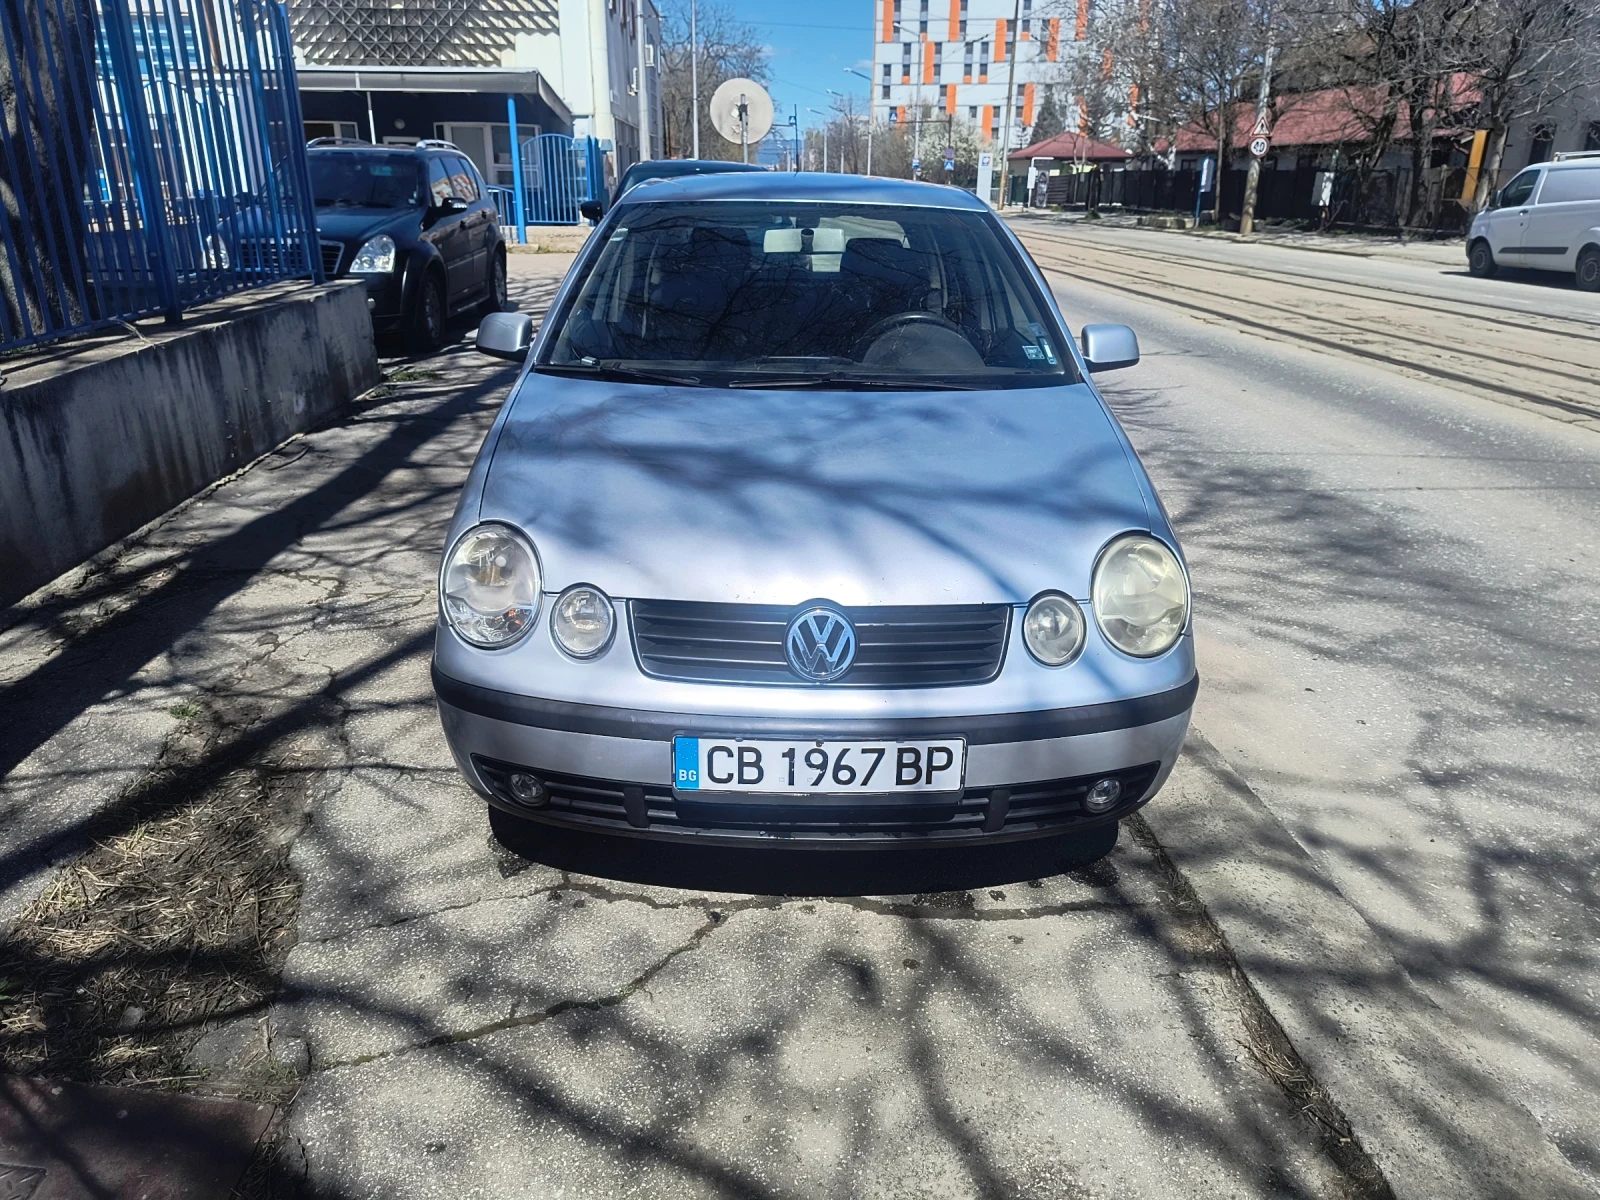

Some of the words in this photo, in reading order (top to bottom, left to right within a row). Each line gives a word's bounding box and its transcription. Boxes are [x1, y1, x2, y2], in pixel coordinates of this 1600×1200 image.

[1253, 141, 1267, 153] 40
[788, 610, 855, 677] VW
[678, 769, 697, 782] BG
[707, 745, 764, 785] CB
[781, 747, 886, 787] 1967
[895, 746, 954, 786] BP
